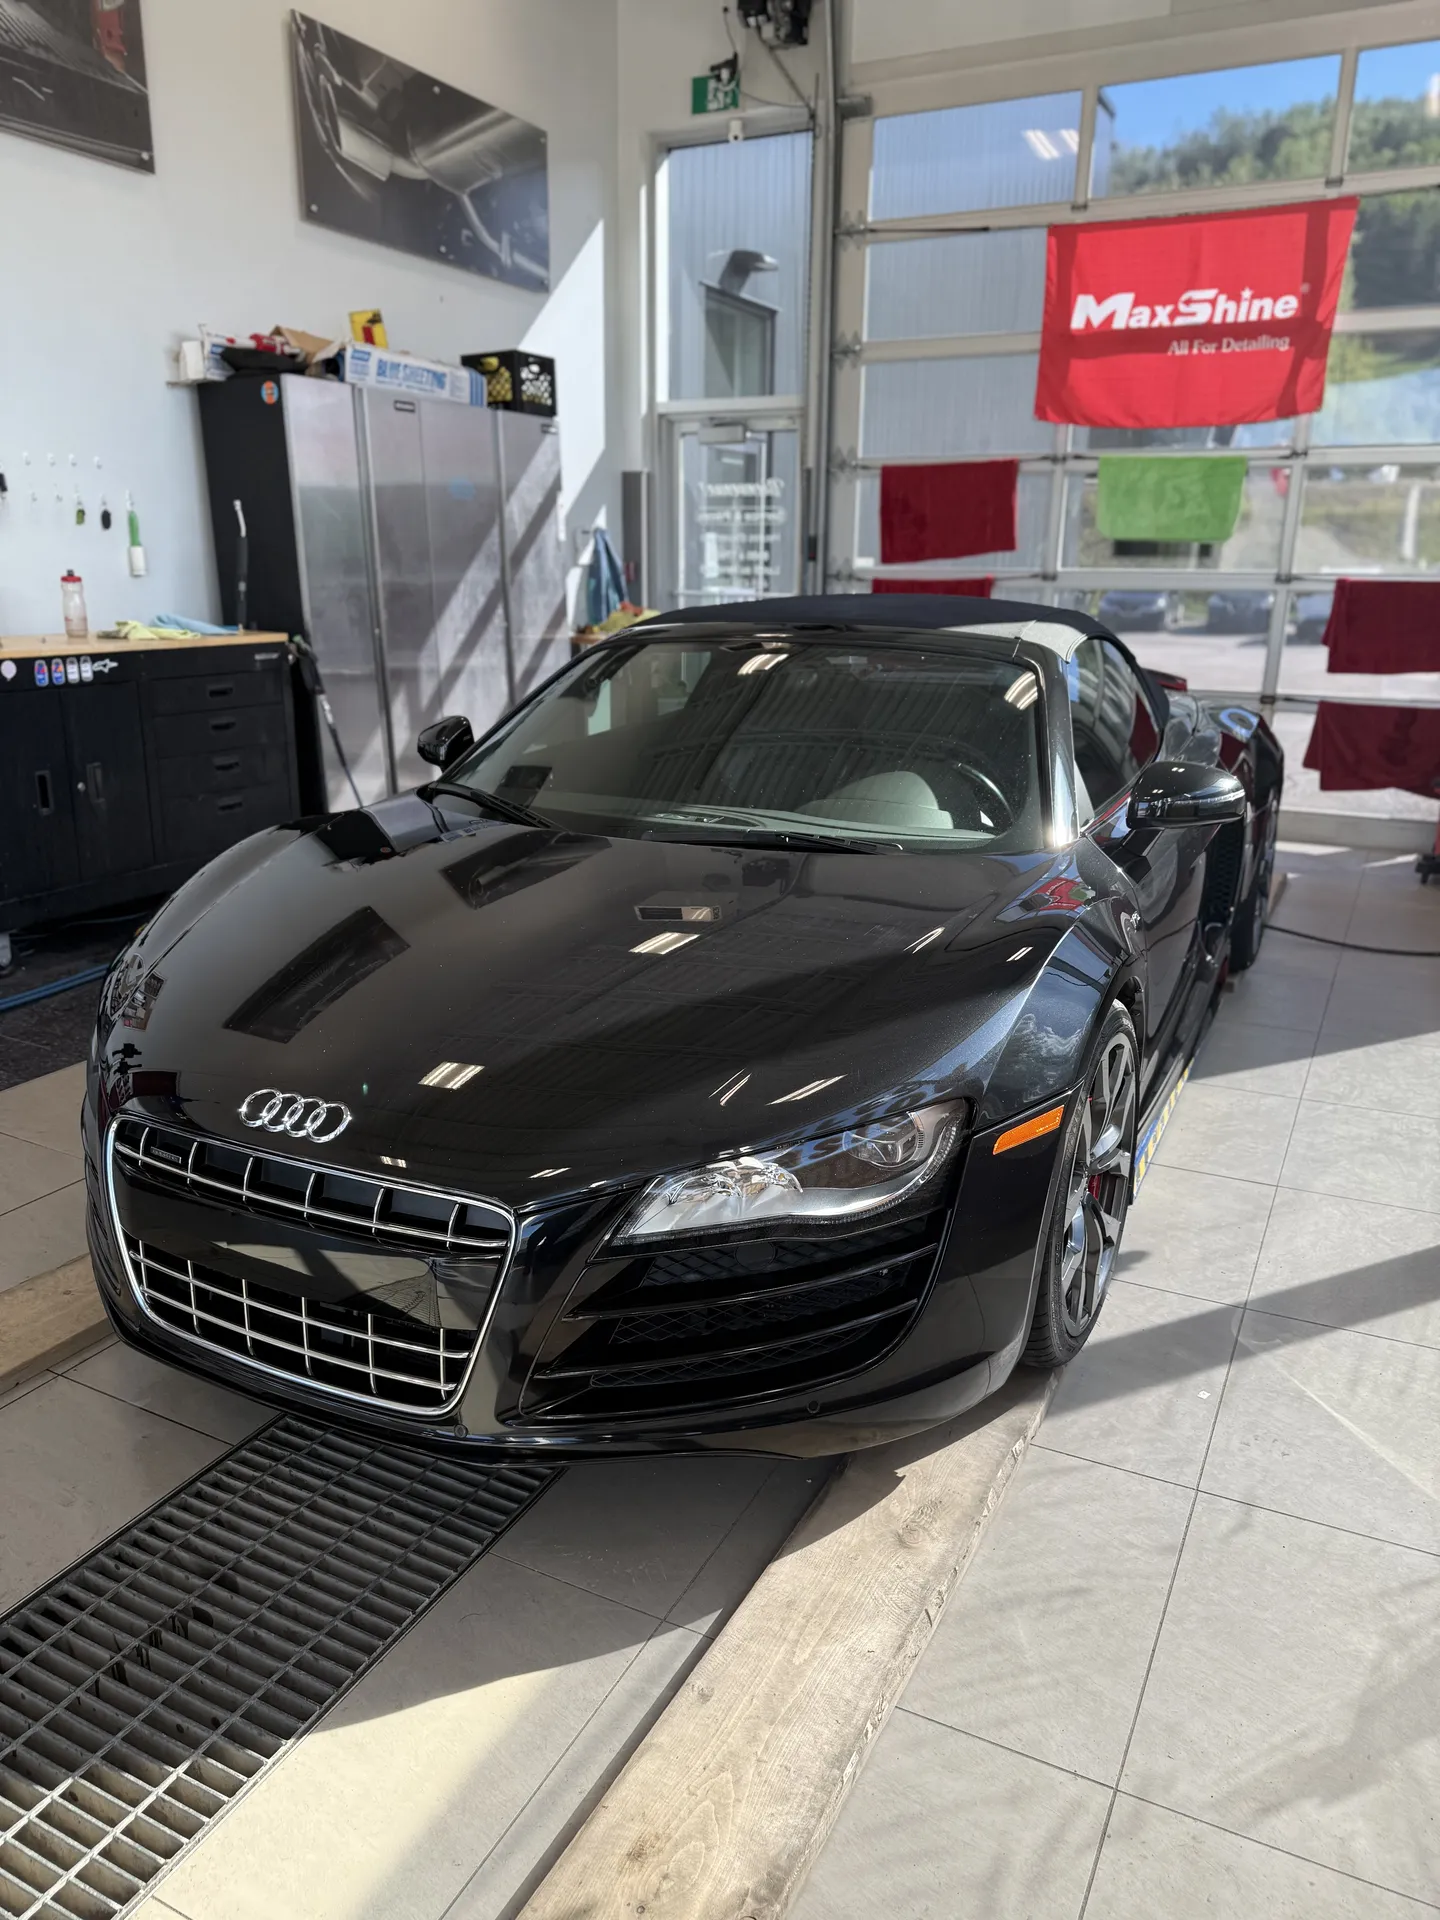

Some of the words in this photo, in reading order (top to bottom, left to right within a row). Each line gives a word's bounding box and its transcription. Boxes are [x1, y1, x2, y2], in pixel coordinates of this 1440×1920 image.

[1070, 286, 1299, 331] MaxShine
[1167, 339, 1190, 356] All
[1193, 338, 1218, 355] For
[1221, 334, 1291, 352] Detailing
